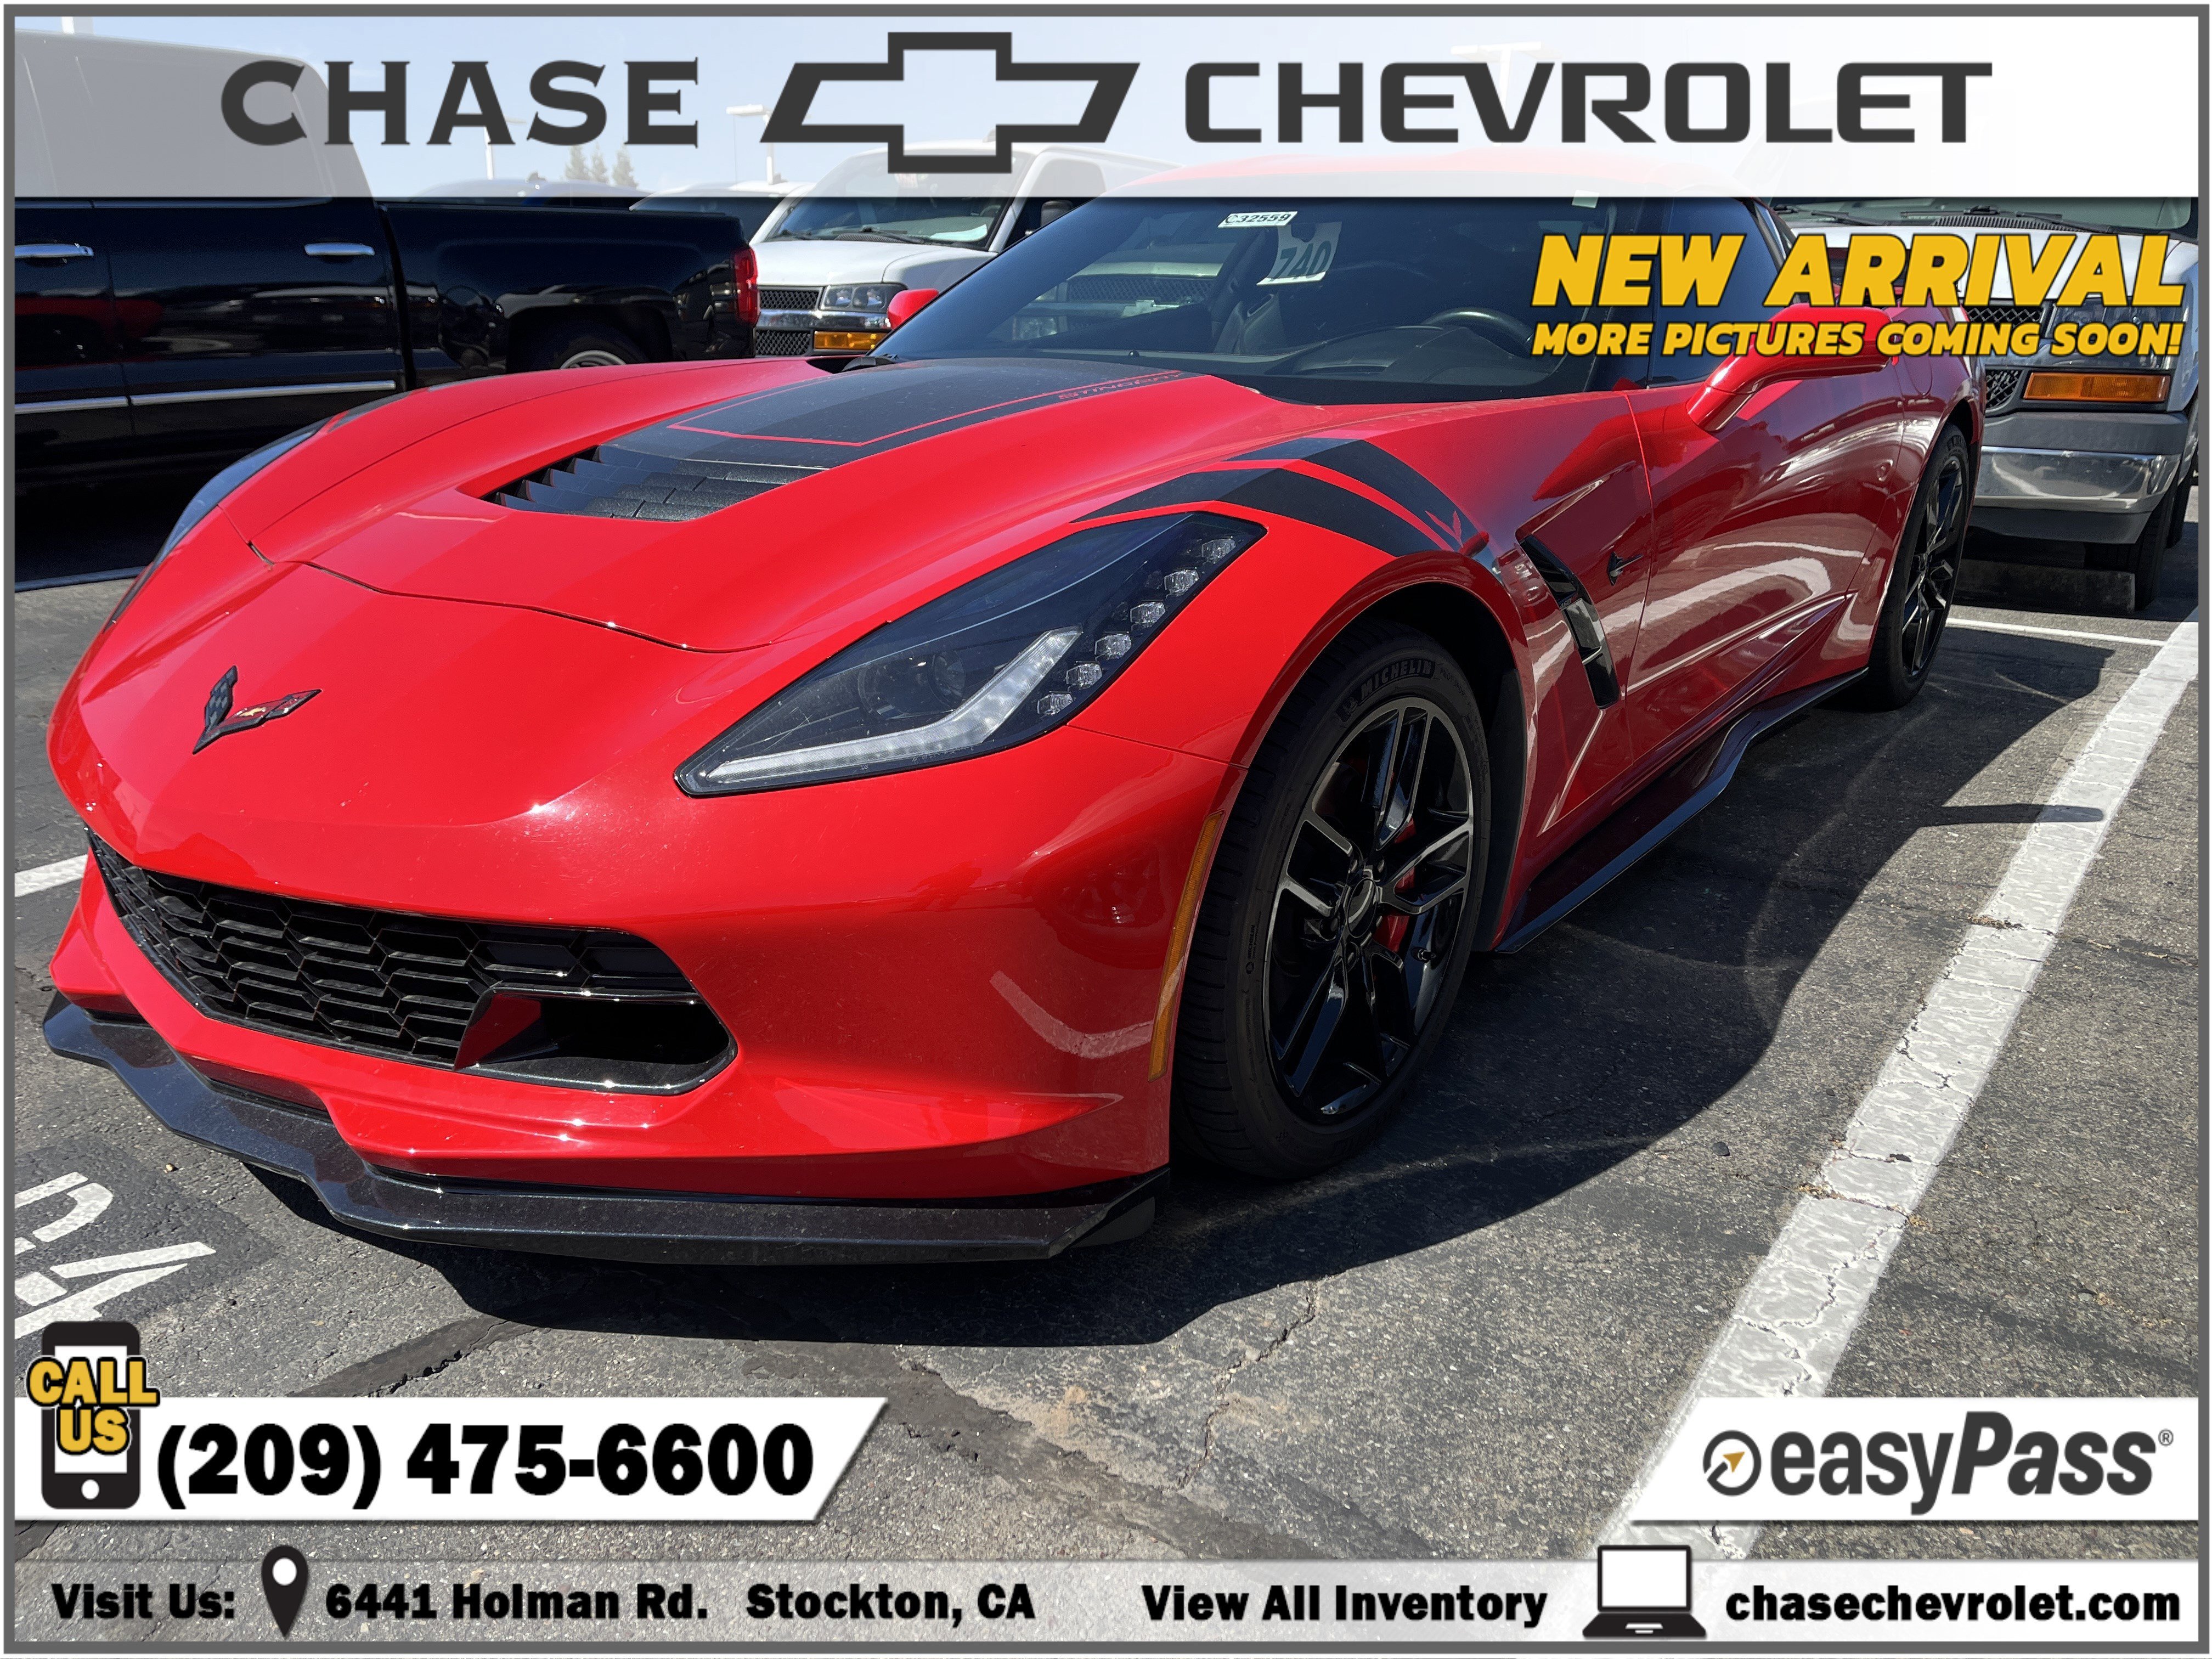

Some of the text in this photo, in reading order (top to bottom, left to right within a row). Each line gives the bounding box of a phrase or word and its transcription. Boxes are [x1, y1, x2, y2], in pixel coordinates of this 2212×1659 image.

[1224, 213, 1291, 224] C32559
[1269, 240, 1332, 282] 740
[1361, 659, 1431, 699] MICHELIN
